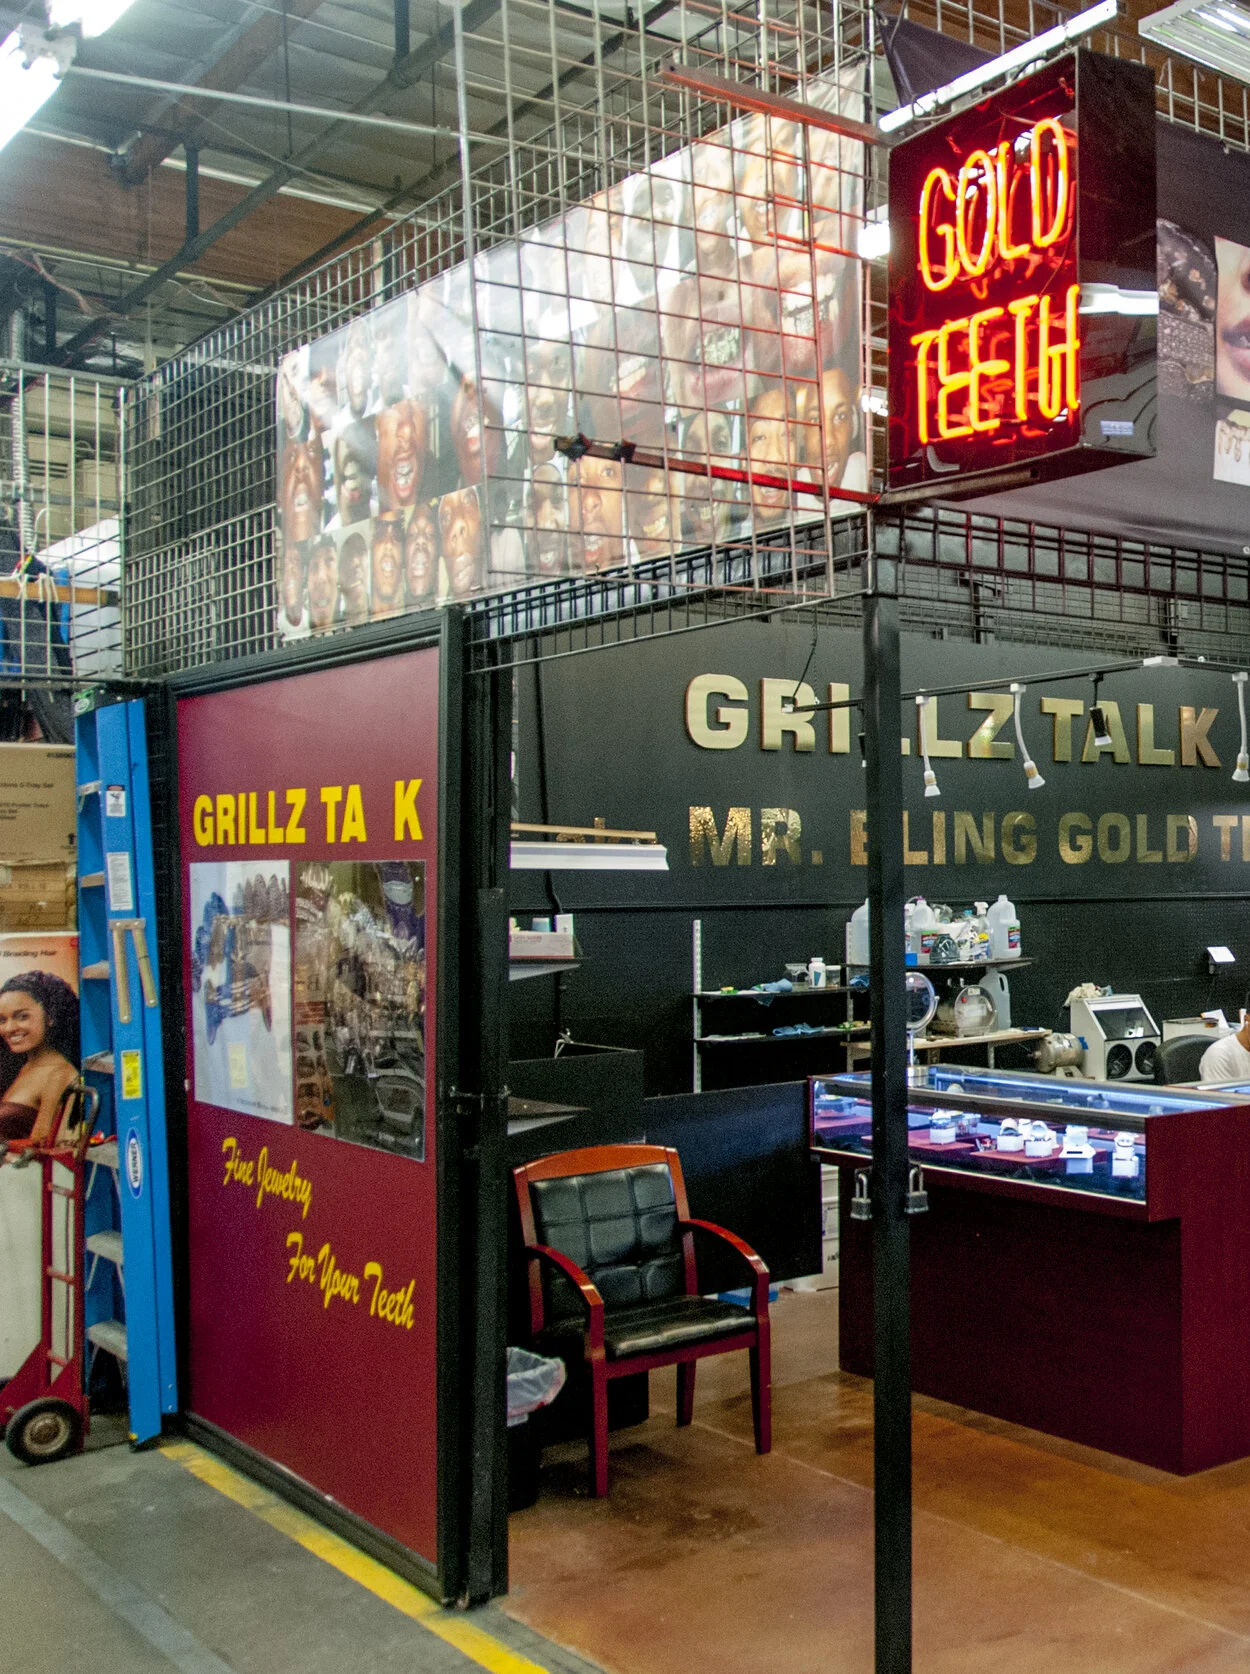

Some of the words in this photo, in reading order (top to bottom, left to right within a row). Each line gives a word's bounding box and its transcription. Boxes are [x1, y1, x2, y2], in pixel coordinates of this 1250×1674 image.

[919, 118, 1069, 292] GOLD
[911, 284, 1081, 444] TEETH
[685, 673, 1015, 760] GRILZ
[1041, 696, 1222, 768] TALK
[193, 787, 307, 847] GRILLZ
[688, 806, 823, 866] MR.
[1058, 812, 1198, 865] GOLD
[129, 1142, 140, 1183] WERNER
[222, 1136, 254, 1186] Fine
[256, 1146, 312, 1219] Jewelry
[286, 1231, 315, 1283] For
[318, 1243, 360, 1309] Your
[364, 1261, 416, 1340] Teeth
